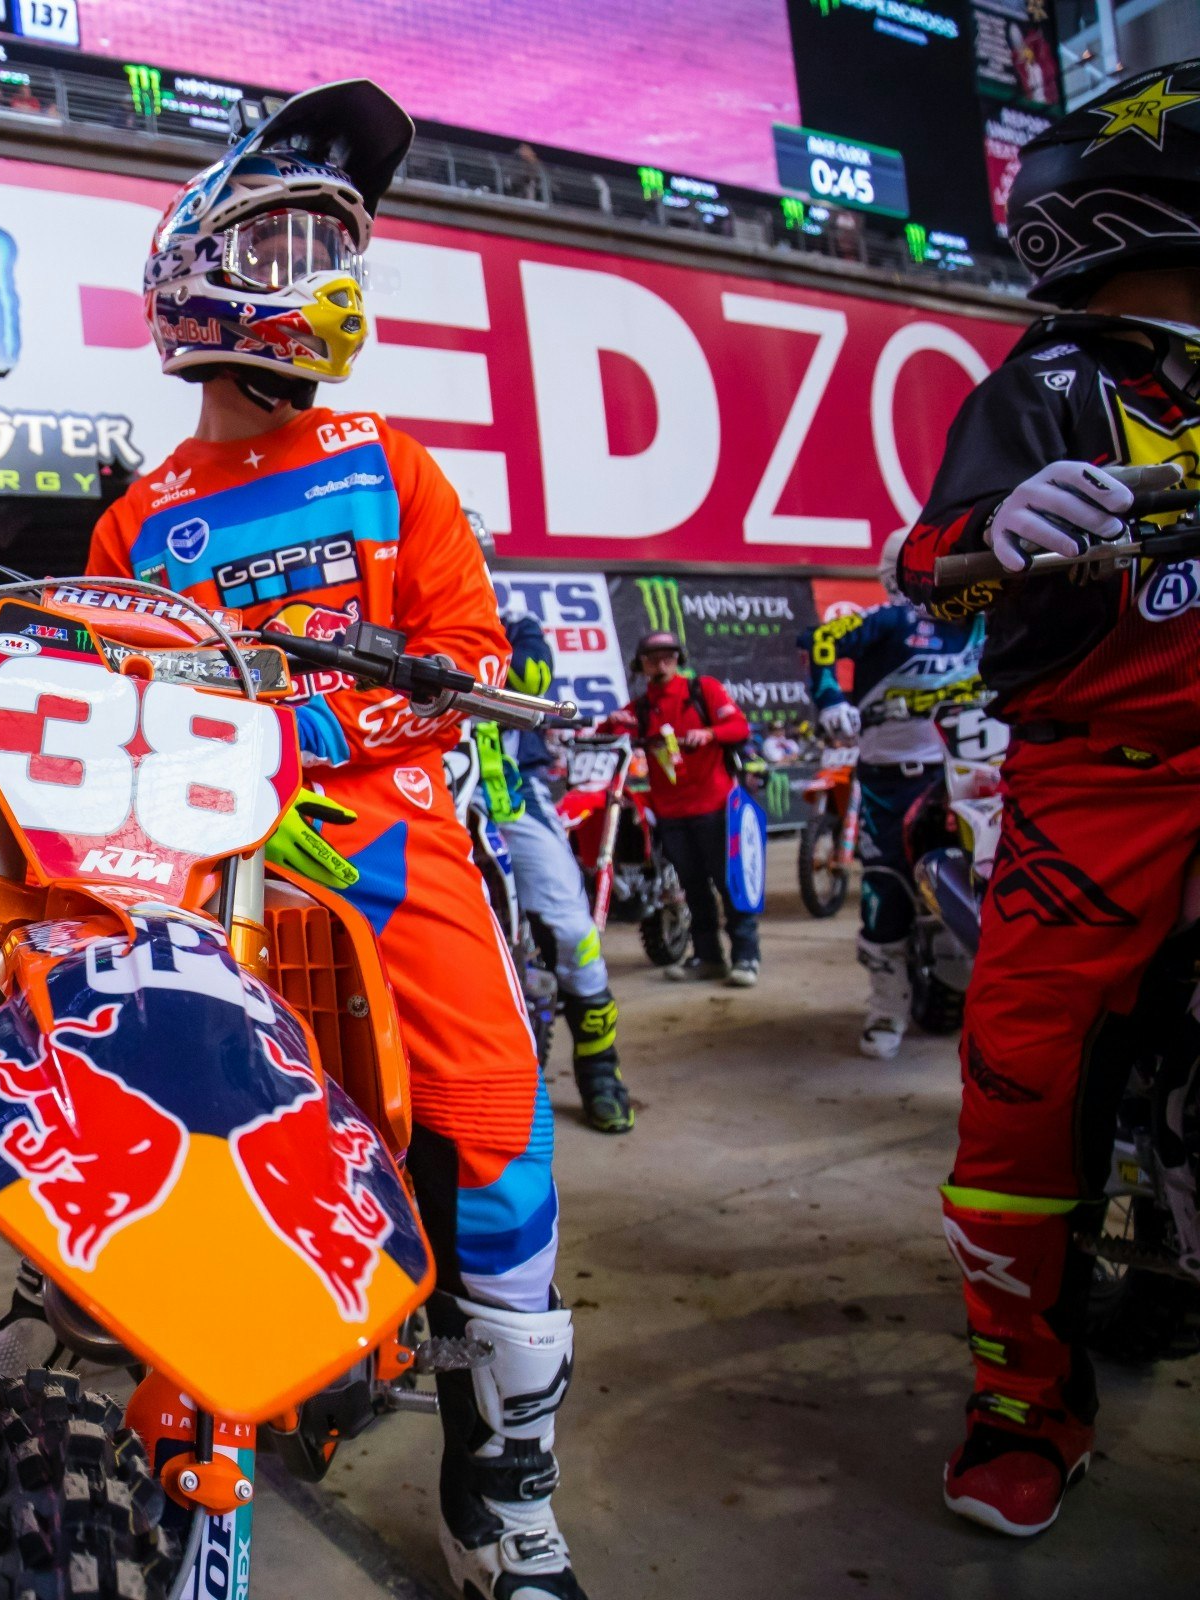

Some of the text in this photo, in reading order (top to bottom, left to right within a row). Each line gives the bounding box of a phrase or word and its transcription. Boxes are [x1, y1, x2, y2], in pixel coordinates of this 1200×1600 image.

[29, 2, 68, 29] 137
[809, 159, 875, 204] 0:45
[318, 418, 377, 446] PPG
[151, 487, 197, 509] adidas
[217, 538, 355, 588] GoPro
[51, 585, 232, 633] RENTHAL
[682, 590, 795, 622] MONSTER
[19, 624, 69, 642] AMA
[78, 846, 175, 885] KTM
[161, 1412, 251, 1437] OALEY
